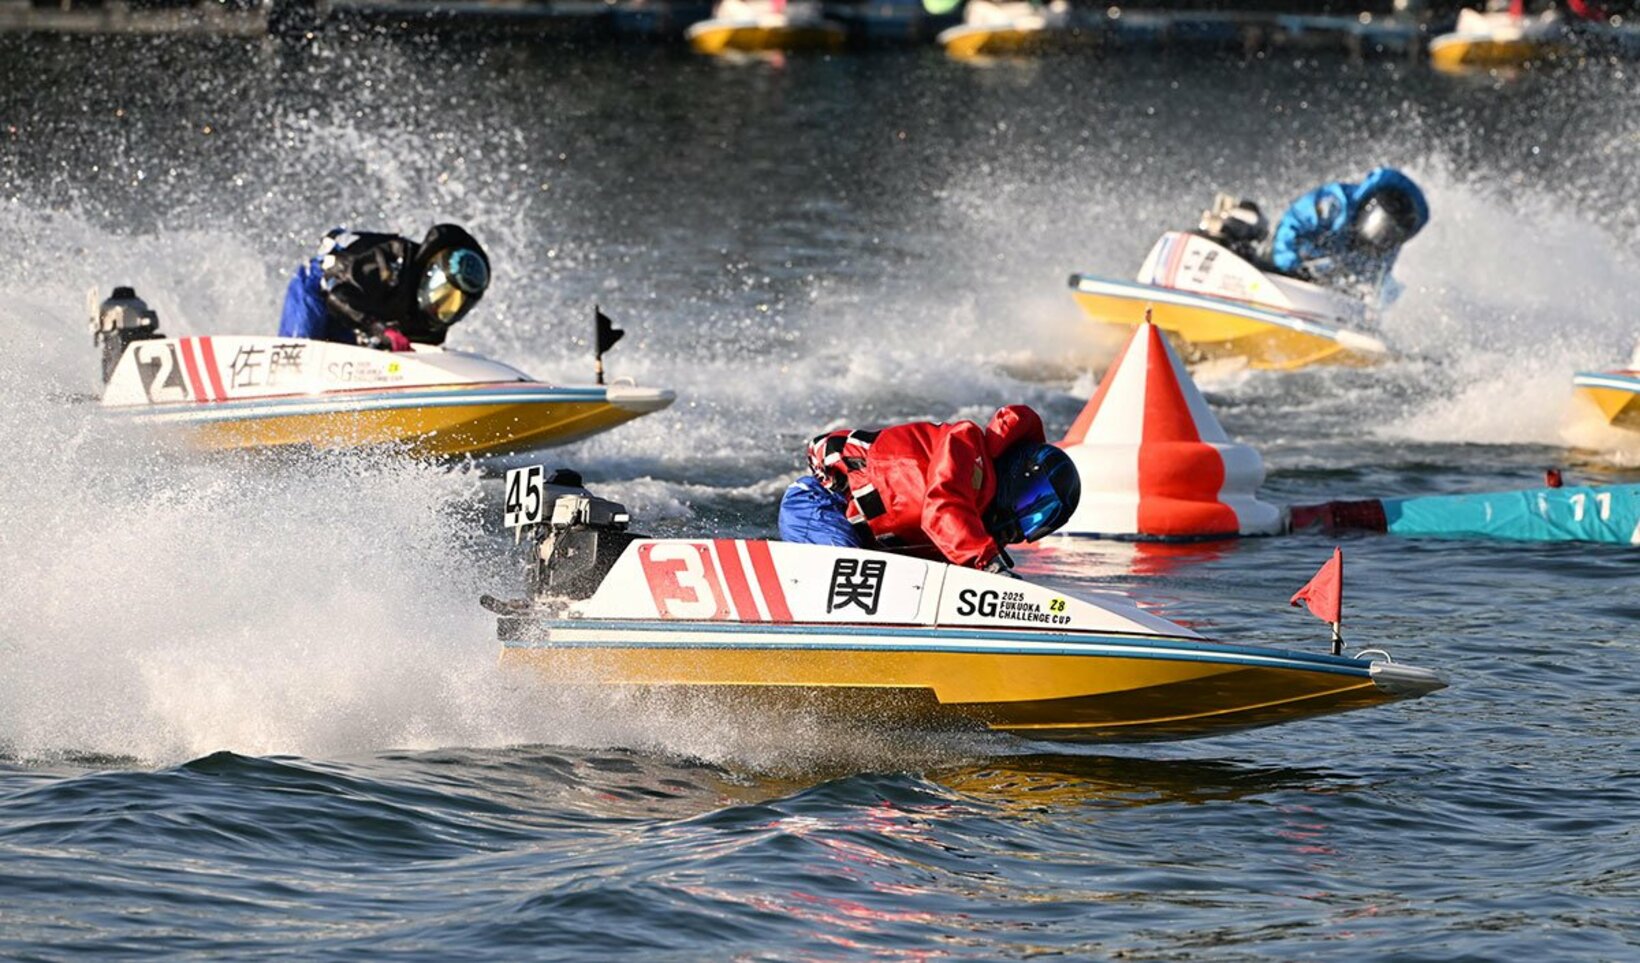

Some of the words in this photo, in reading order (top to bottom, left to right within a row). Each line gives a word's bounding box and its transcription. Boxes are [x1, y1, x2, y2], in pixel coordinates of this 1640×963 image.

[140, 344, 186, 402] 2
[506, 467, 541, 523] 45
[650, 544, 718, 619] 3
[826, 558, 888, 615] 関
[1002, 592, 1024, 602] 2025
[956, 589, 999, 617] SG
[998, 611, 1050, 623] CHALLENGE
[1051, 615, 1071, 625] CUP
[1000, 601, 1040, 612] FUKUOKA
